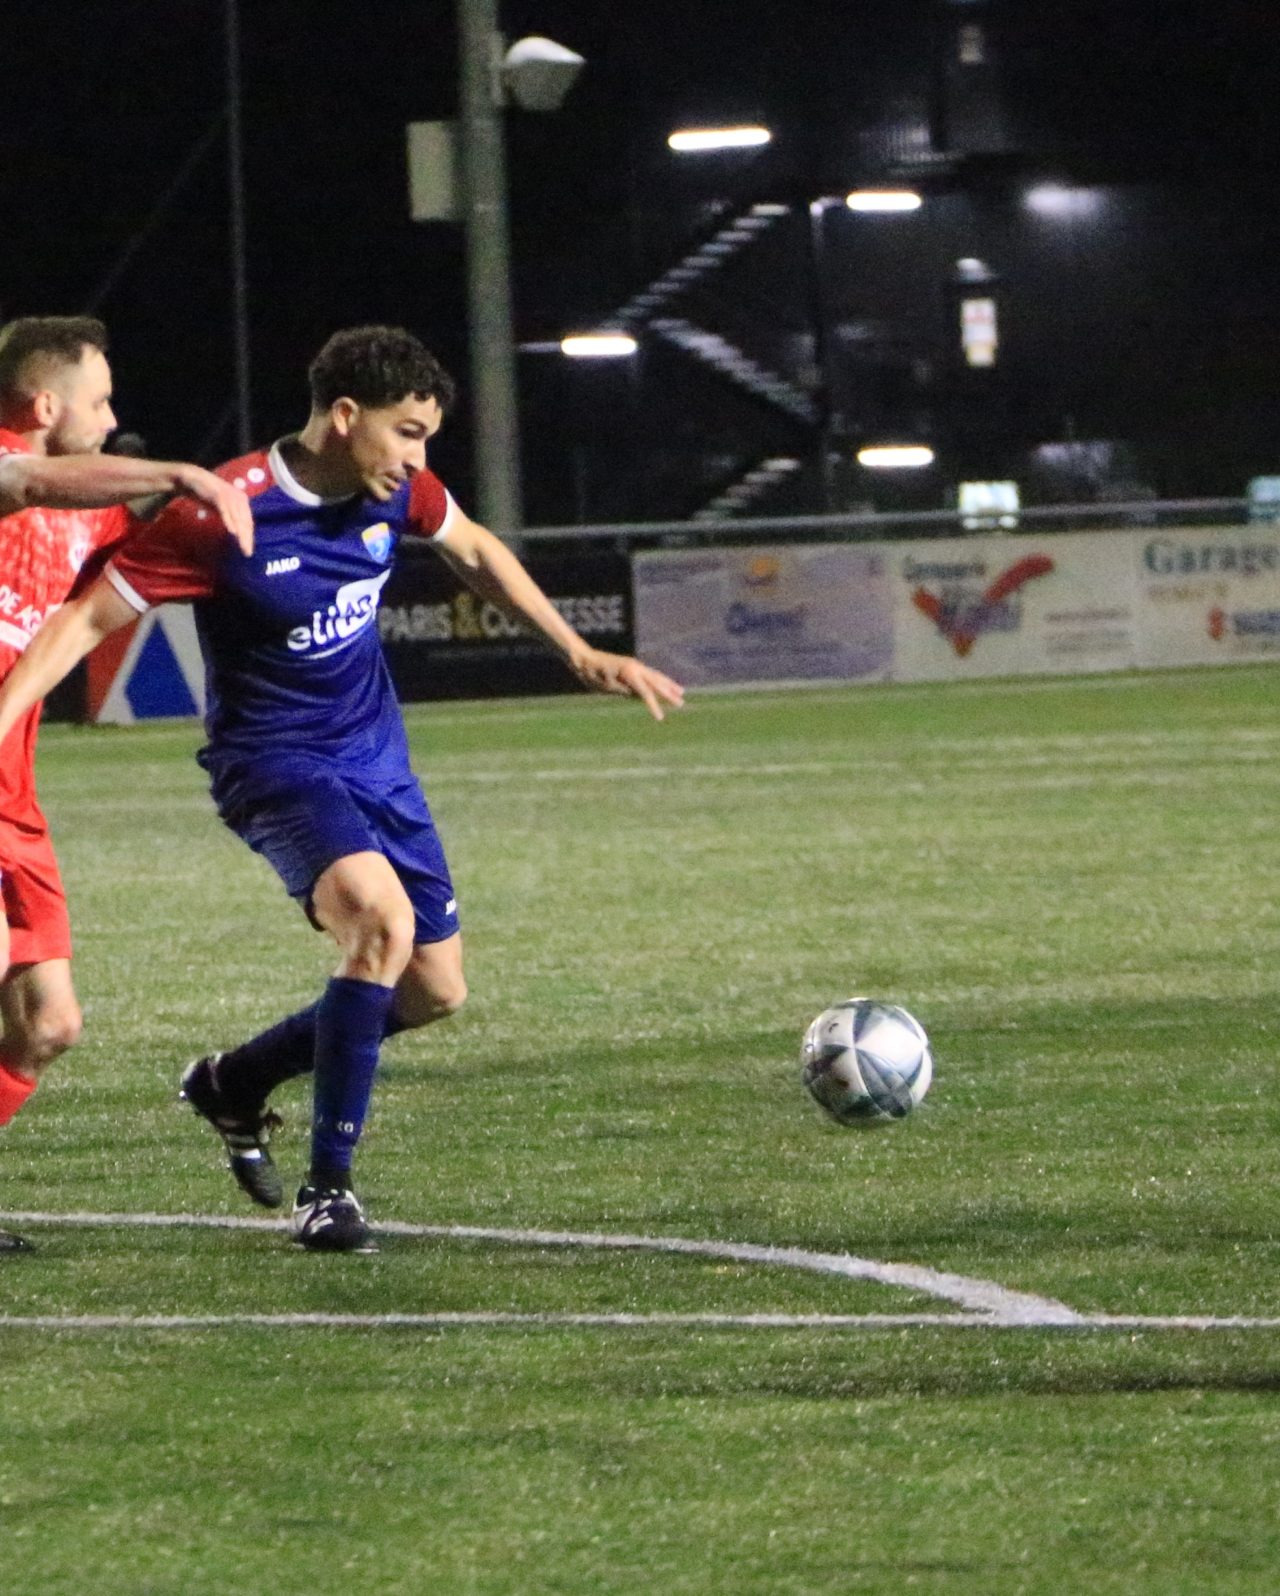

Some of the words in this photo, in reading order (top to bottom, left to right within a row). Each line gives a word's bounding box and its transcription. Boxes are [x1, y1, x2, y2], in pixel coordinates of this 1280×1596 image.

[265, 556, 300, 576] JAKO
[1144, 539, 1279, 578] Garage
[380, 604, 452, 642] PARIS
